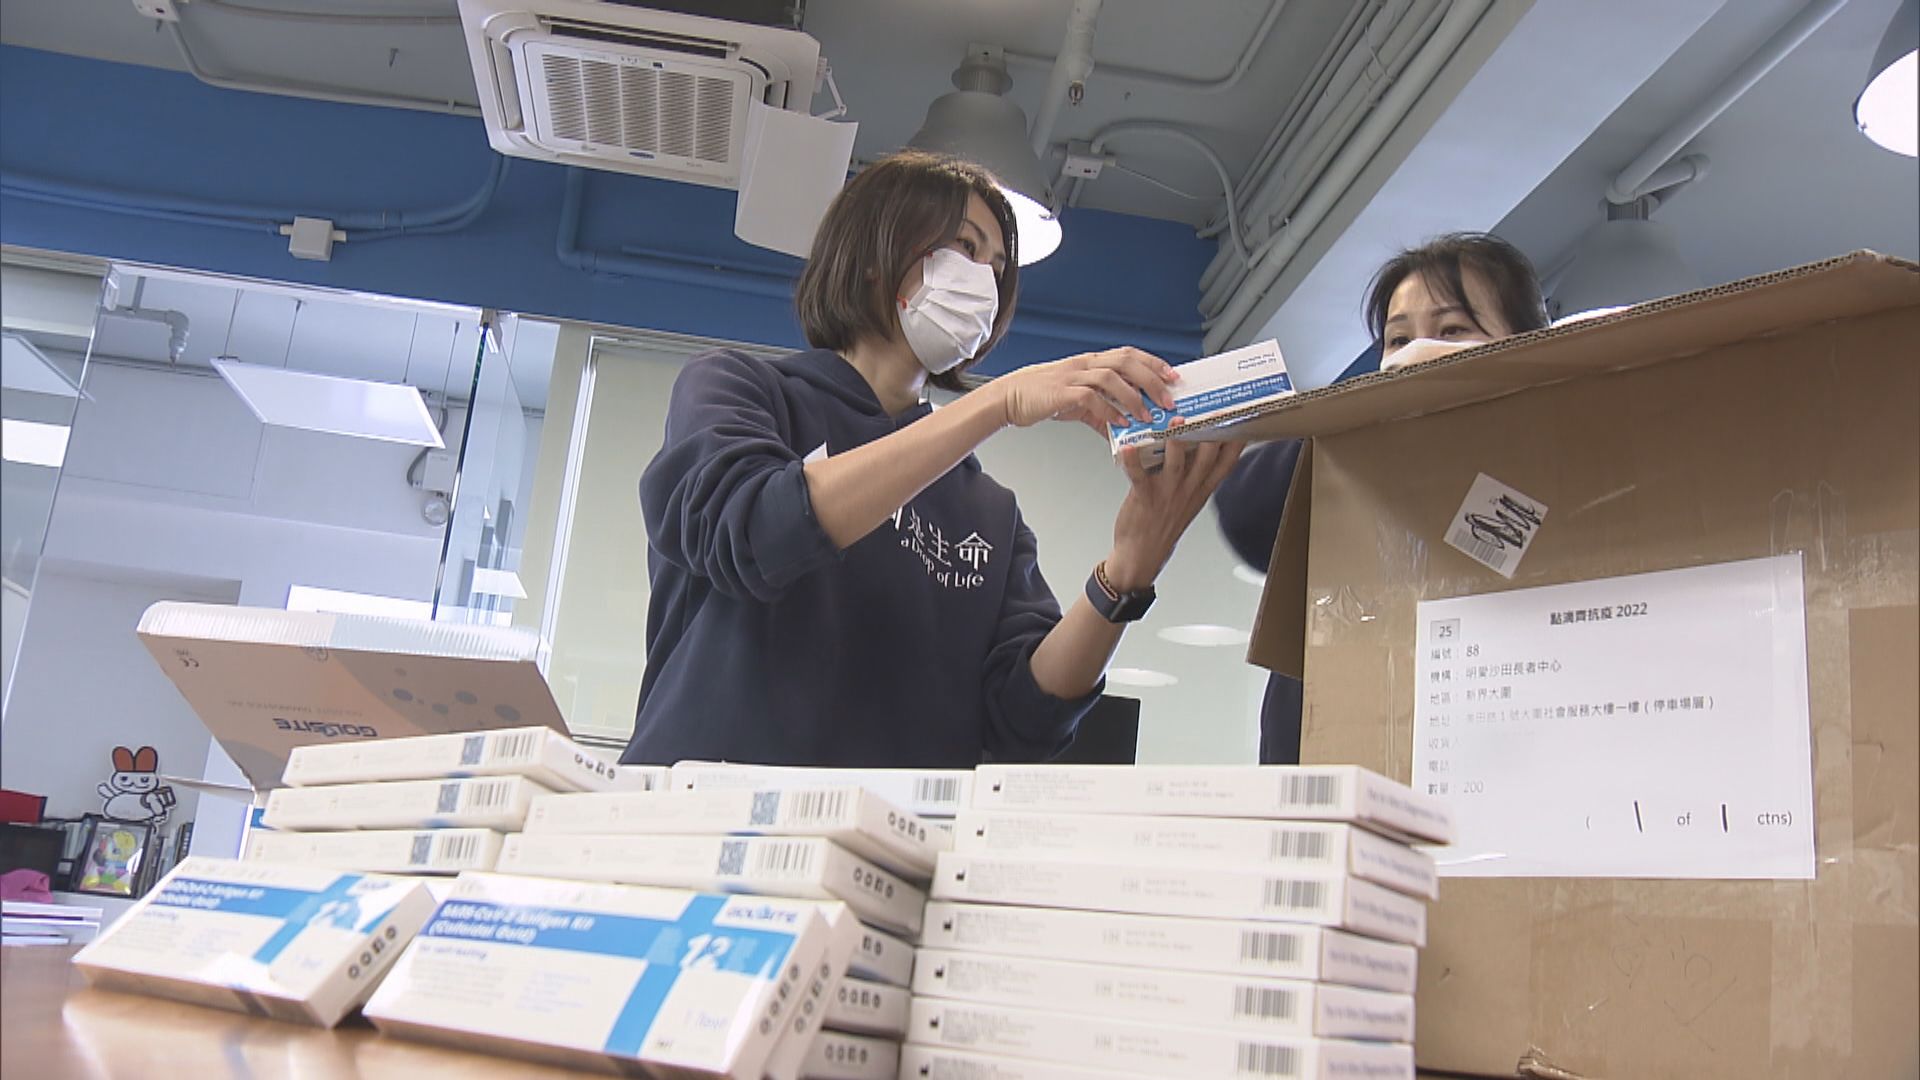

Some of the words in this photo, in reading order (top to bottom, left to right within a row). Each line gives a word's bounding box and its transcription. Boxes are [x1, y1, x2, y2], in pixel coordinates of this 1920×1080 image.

[892, 506, 993, 571] 是生命
[911, 537, 935, 575] Drop
[936, 571, 950, 588] of
[954, 570, 985, 589] Life
[1616, 602, 1649, 618] 2022
[1439, 625, 1453, 638] 25
[1466, 644, 1480, 657] 88
[1463, 780, 1484, 794] 200
[1676, 812, 1691, 826] of
[1757, 811, 1793, 828] ctns)
